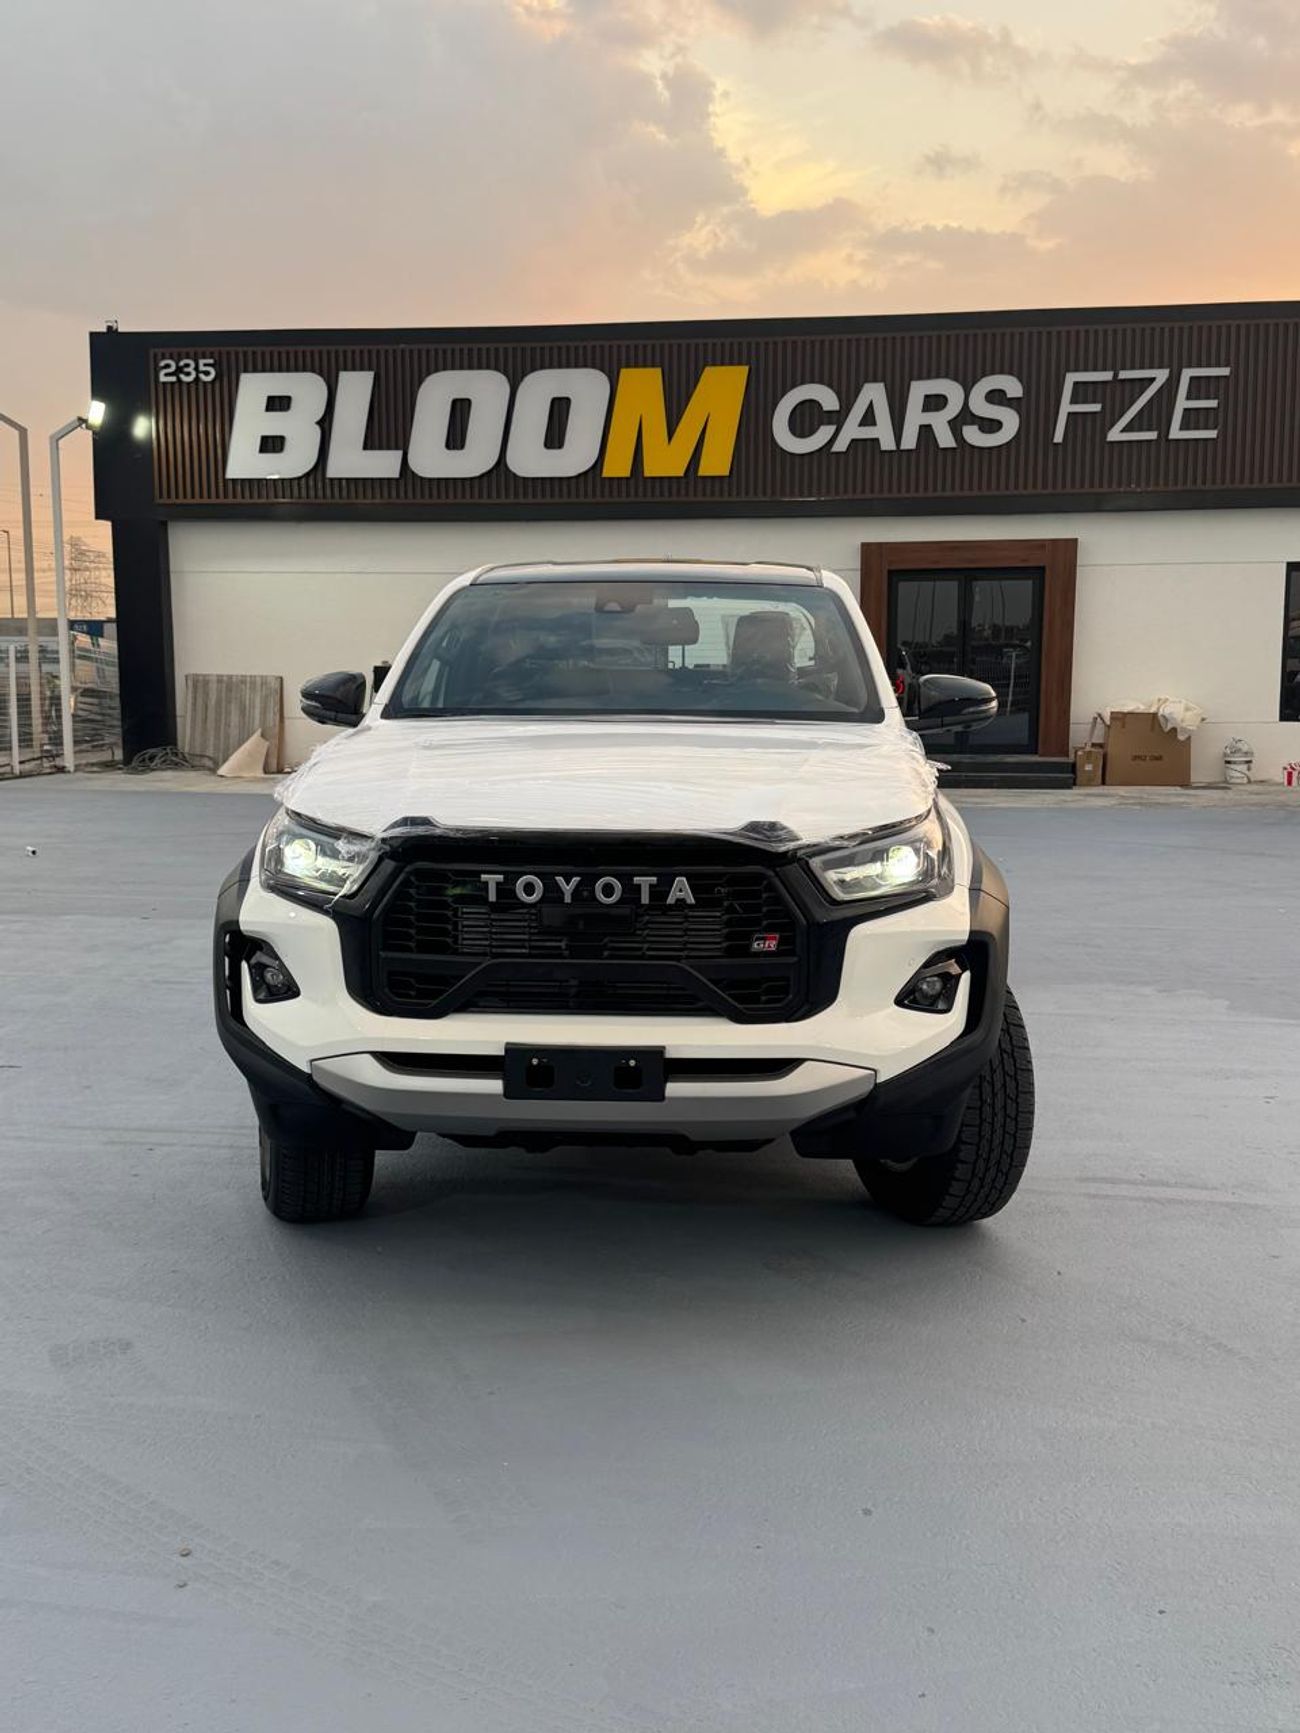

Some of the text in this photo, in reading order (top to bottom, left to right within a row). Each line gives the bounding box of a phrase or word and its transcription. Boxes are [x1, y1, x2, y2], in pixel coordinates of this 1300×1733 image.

[159, 359, 215, 382] 235
[225, 366, 1231, 479] BLOOM CARS FZE
[480, 874, 695, 905] TOYOTA
[752, 938, 777, 951] GR
